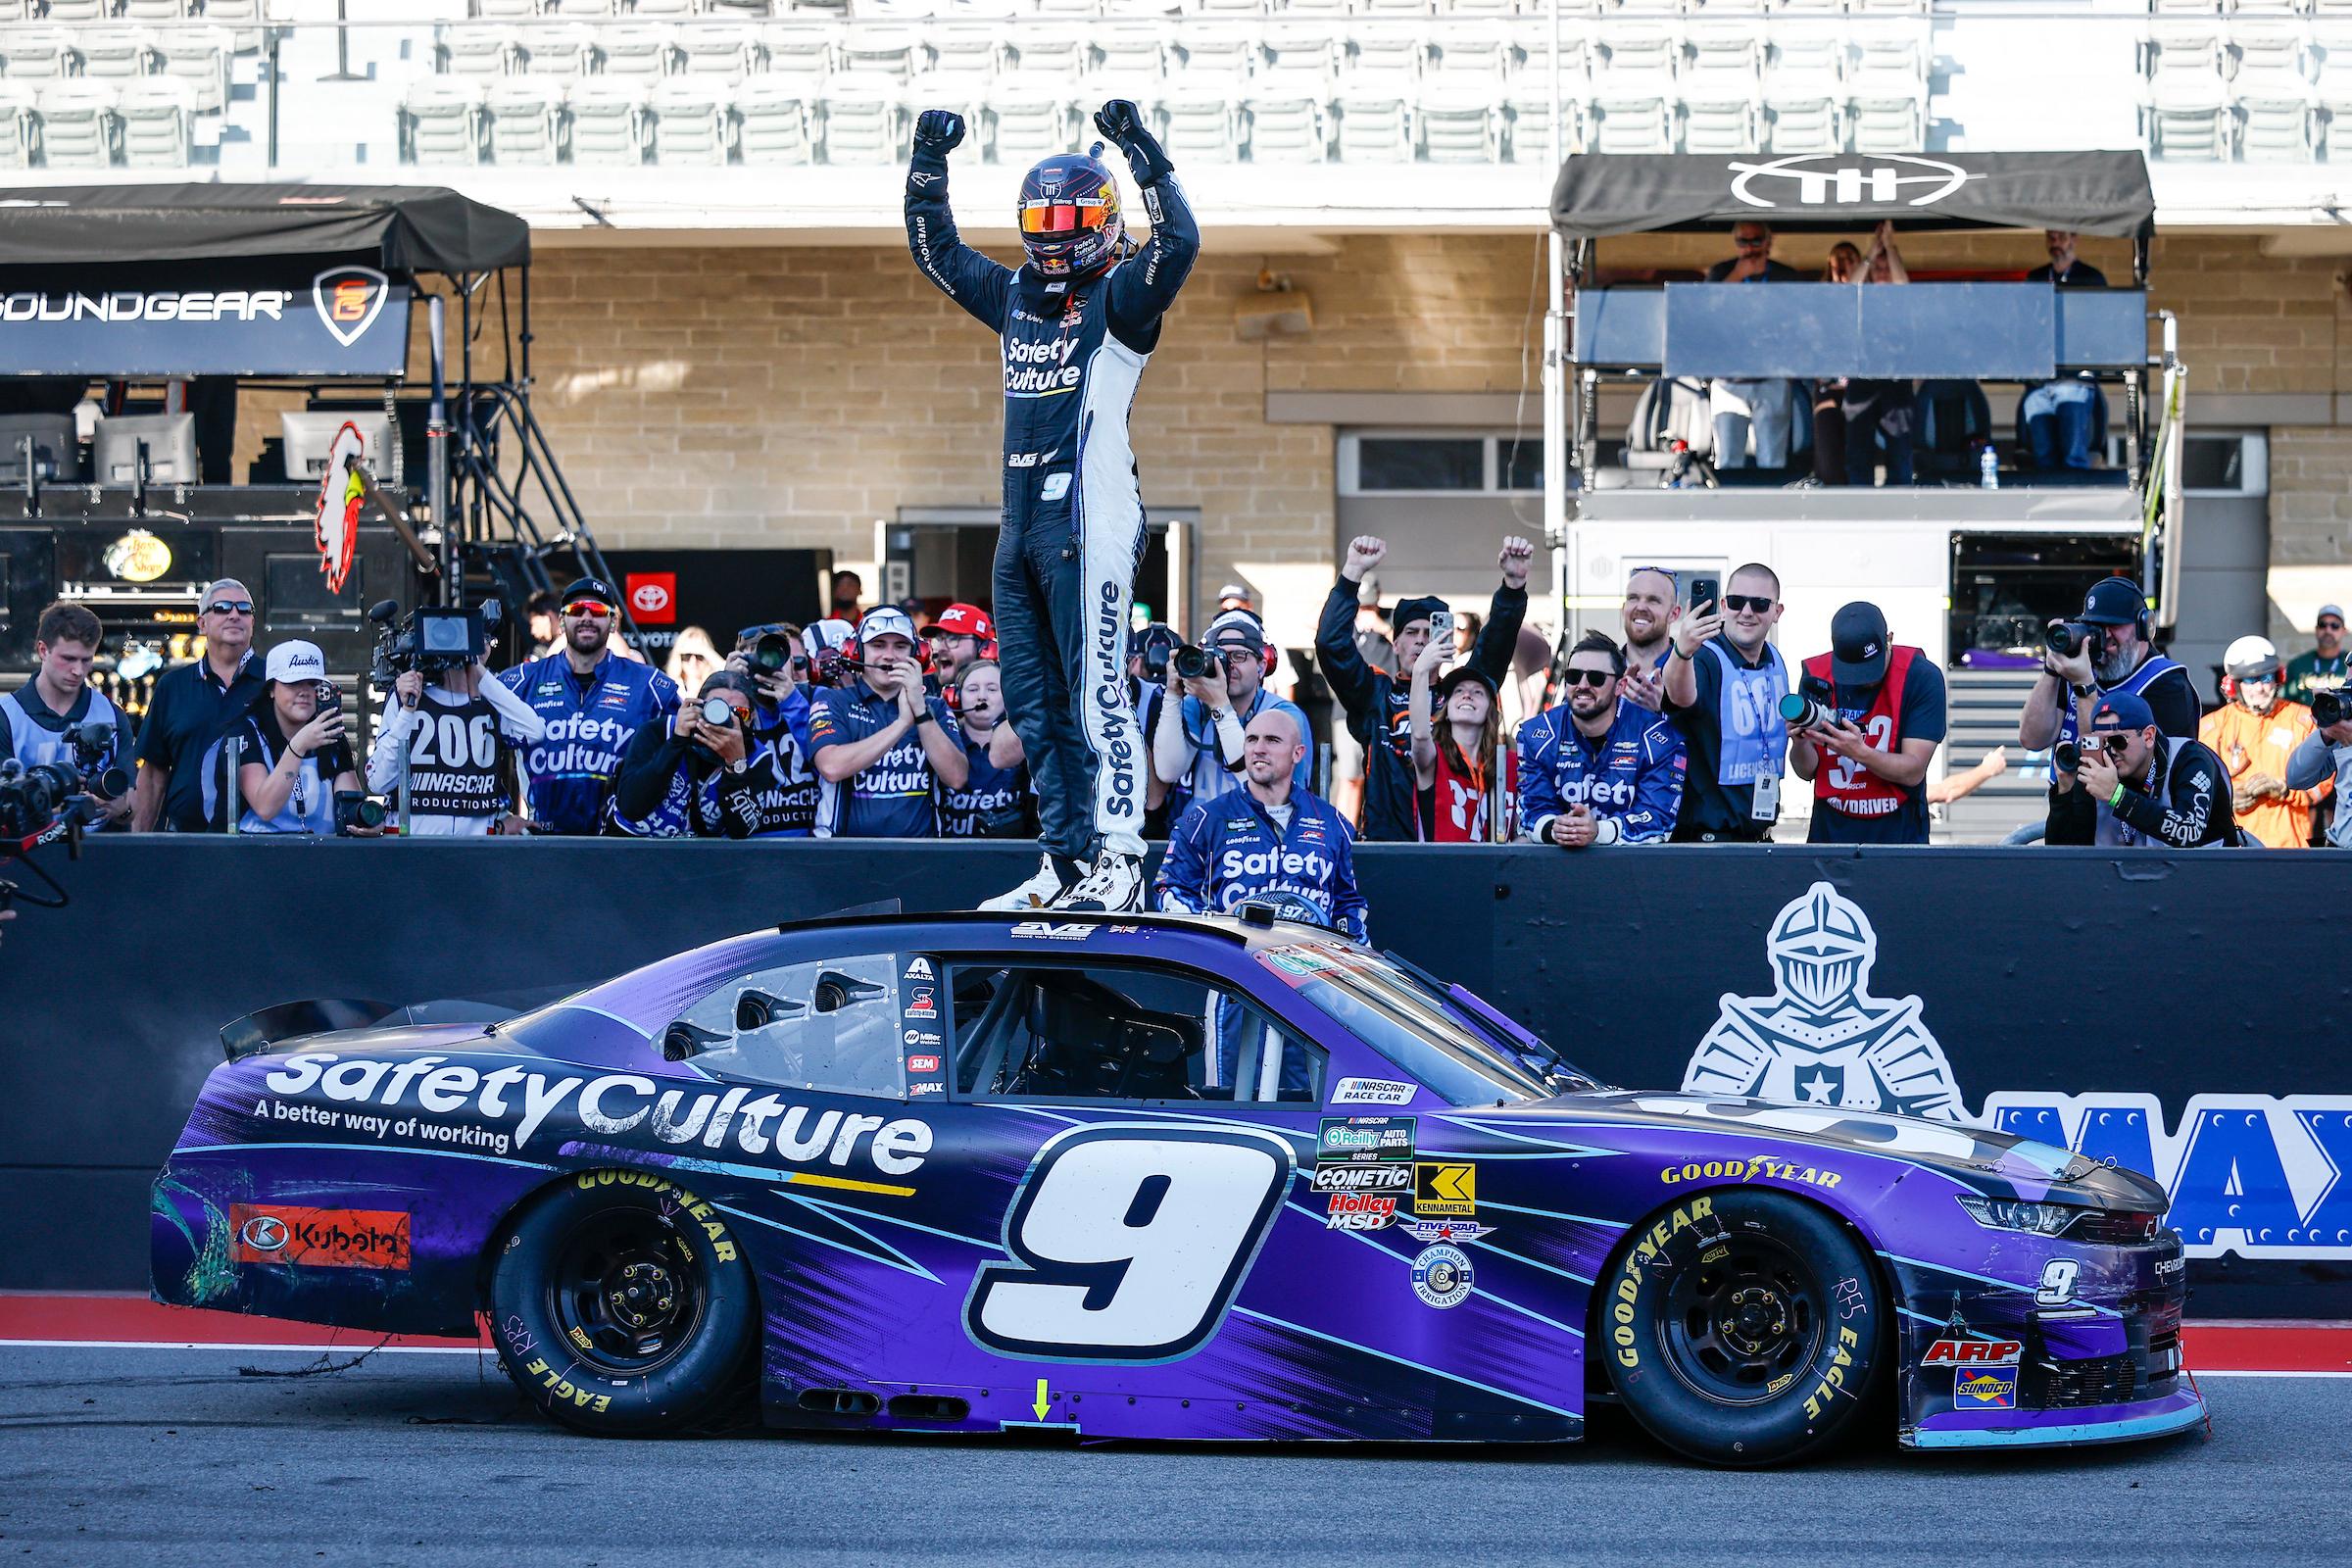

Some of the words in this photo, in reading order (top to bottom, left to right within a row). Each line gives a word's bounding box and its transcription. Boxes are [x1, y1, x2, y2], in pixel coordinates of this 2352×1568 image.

[0, 291, 283, 321] OUNDGEAR
[1007, 336, 1080, 367] Safety
[1005, 365, 1081, 391] Culture
[1041, 472, 1073, 502] 9
[289, 654, 320, 668] Austin
[410, 710, 496, 769] 206
[540, 711, 635, 752] afety
[529, 743, 623, 774] Cultur
[426, 772, 495, 795] NASCAR
[853, 769, 930, 793] Culture
[412, 798, 498, 809] RODUCTIONS
[1225, 835, 1260, 845] GOODYEAR
[1222, 844, 1334, 885] Safety
[1009, 921, 1102, 938] SVG
[904, 972, 935, 982] AXALTA
[919, 1033, 942, 1042] Miller
[911, 1058, 934, 1069] SEM
[1344, 1092, 1375, 1101] RACE
[1377, 1093, 1401, 1102] CAR
[1360, 1081, 1406, 1094] NASCAR
[254, 1101, 270, 1117] A
[274, 1101, 341, 1128] better
[344, 1114, 390, 1139] way
[394, 1117, 416, 1138] of
[419, 1123, 510, 1154] working
[1326, 1127, 1381, 1150] O'Reilly
[1380, 1138, 1408, 1148] PARTS
[1316, 1168, 1410, 1187] COMETIC
[1328, 1193, 1396, 1217] Holley
[1416, 1202, 1473, 1214] KENNAMETAL
[1326, 1214, 1388, 1231] MSD
[1417, 1222, 1446, 1231] FIVE
[1448, 1223, 1477, 1233] STAR
[295, 1222, 398, 1253] Kubota
[968, 1128, 1290, 1360] 9
[1418, 1248, 1467, 1267] CHAMPION
[2034, 1257, 2082, 1307] 9
[1417, 1284, 1468, 1305] IRRIGATION
[1923, 1341, 2021, 1361] ARP
[1802, 1325, 1859, 1421] EAGLE
[526, 1357, 612, 1413] EAGLE
[1958, 1381, 2013, 1396] SUNOCO
